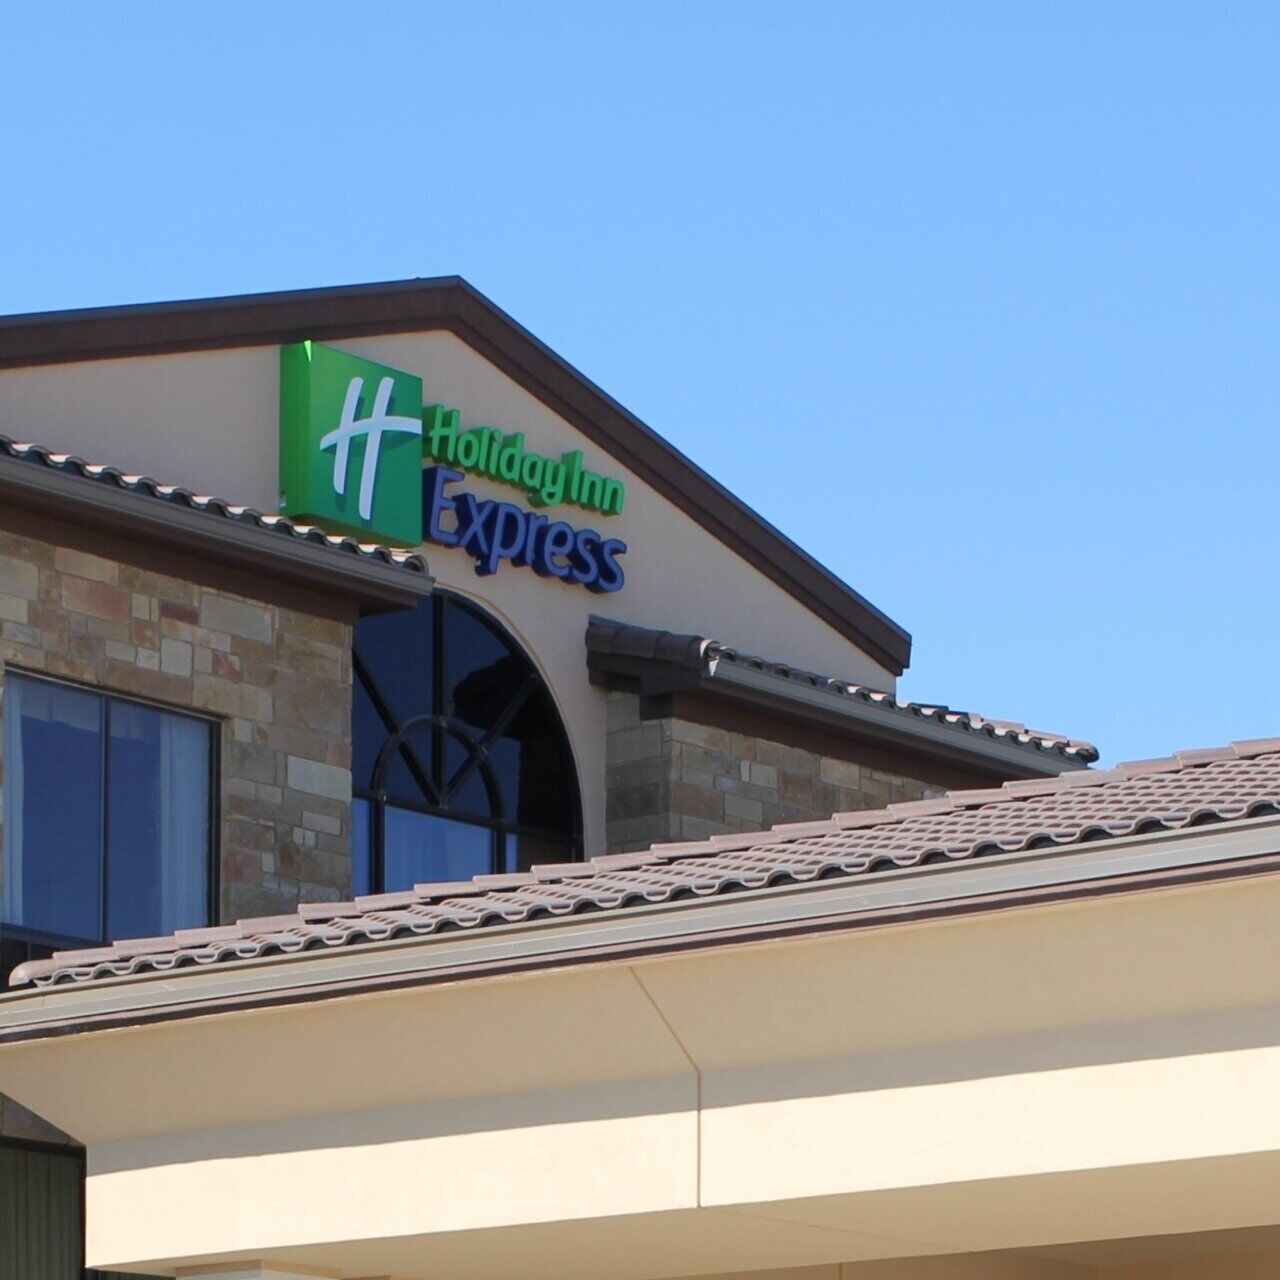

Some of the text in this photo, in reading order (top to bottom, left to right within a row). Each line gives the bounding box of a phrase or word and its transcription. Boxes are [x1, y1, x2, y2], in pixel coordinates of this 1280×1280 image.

[424, 404, 625, 517] Holiday Inn
[424, 466, 628, 593] Express
